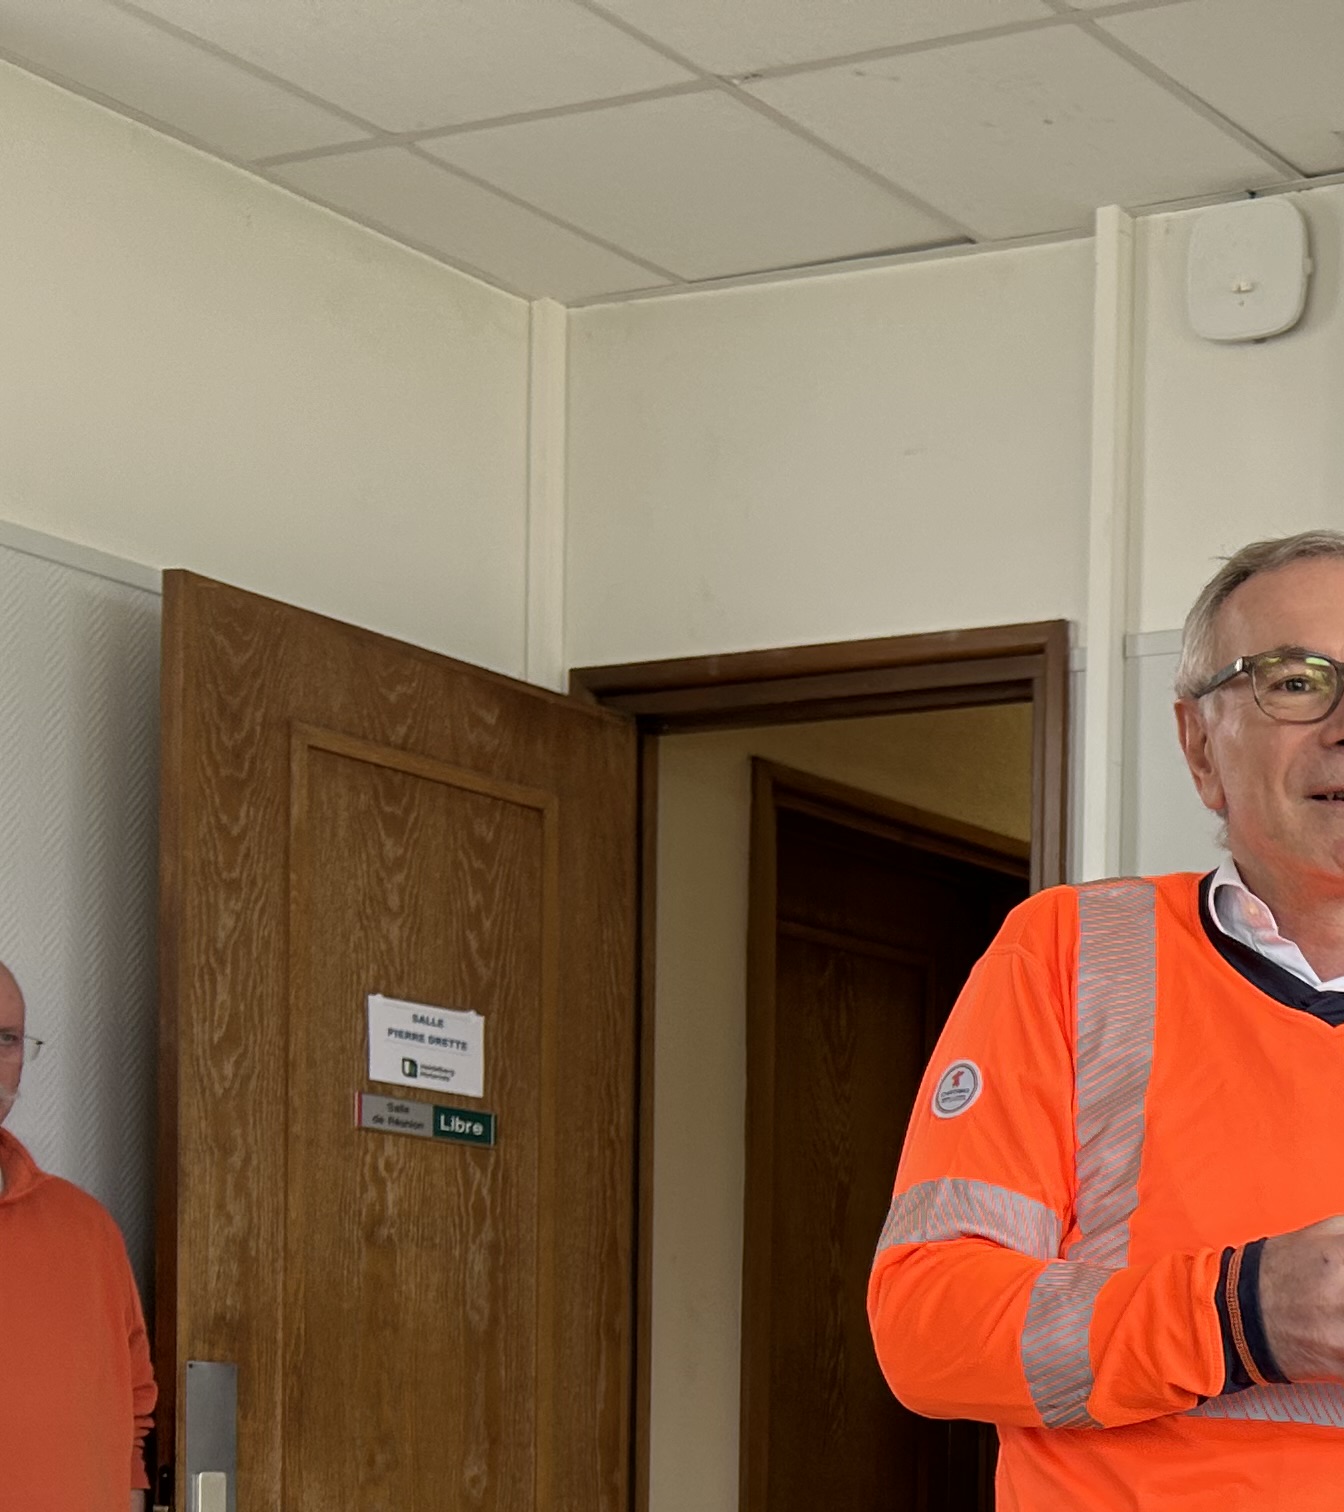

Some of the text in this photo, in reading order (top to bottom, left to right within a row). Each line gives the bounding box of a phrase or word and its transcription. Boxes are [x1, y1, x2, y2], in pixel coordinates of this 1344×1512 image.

[412, 1013, 444, 1028] SALLE
[386, 1102, 410, 1114] Salle
[372, 1114, 384, 1124] de
[440, 1114, 484, 1136] Libre
